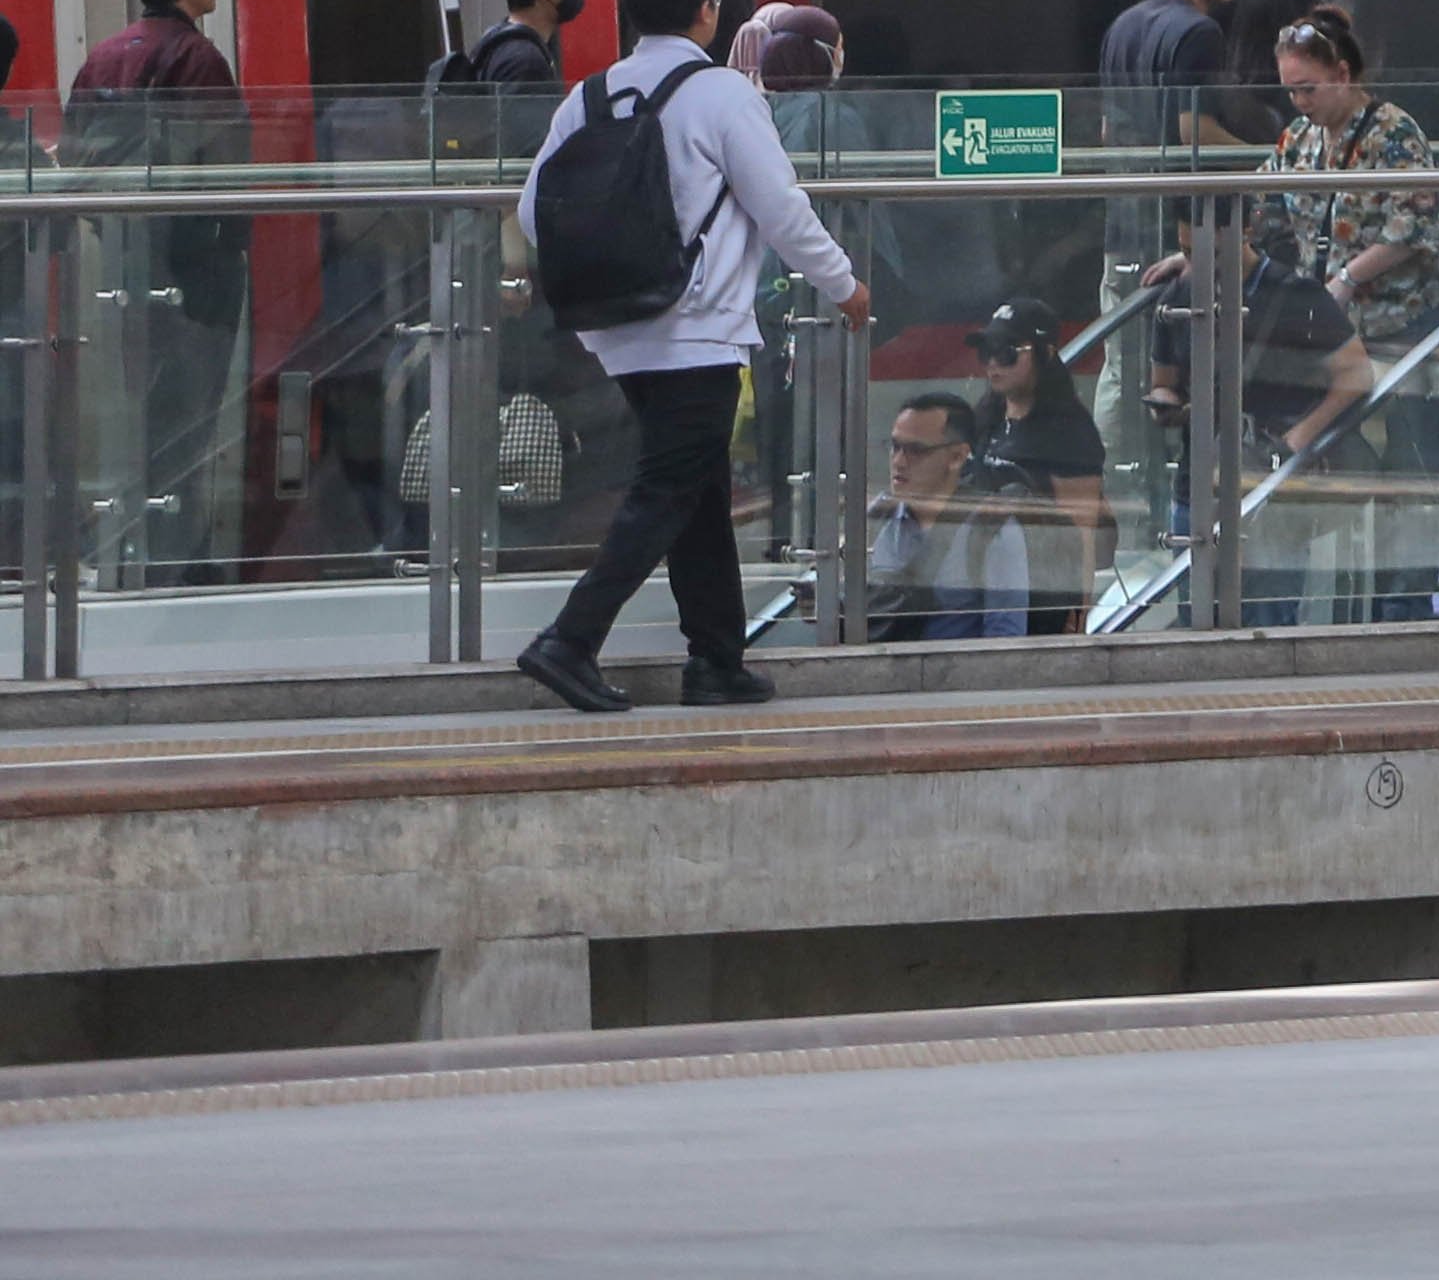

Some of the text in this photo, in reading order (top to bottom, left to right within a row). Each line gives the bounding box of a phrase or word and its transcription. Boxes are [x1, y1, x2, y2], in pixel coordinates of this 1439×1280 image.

[990, 126, 1056, 138] JALUR EVAKUASI
[991, 143, 1055, 154] EVACUATION ROUTE
